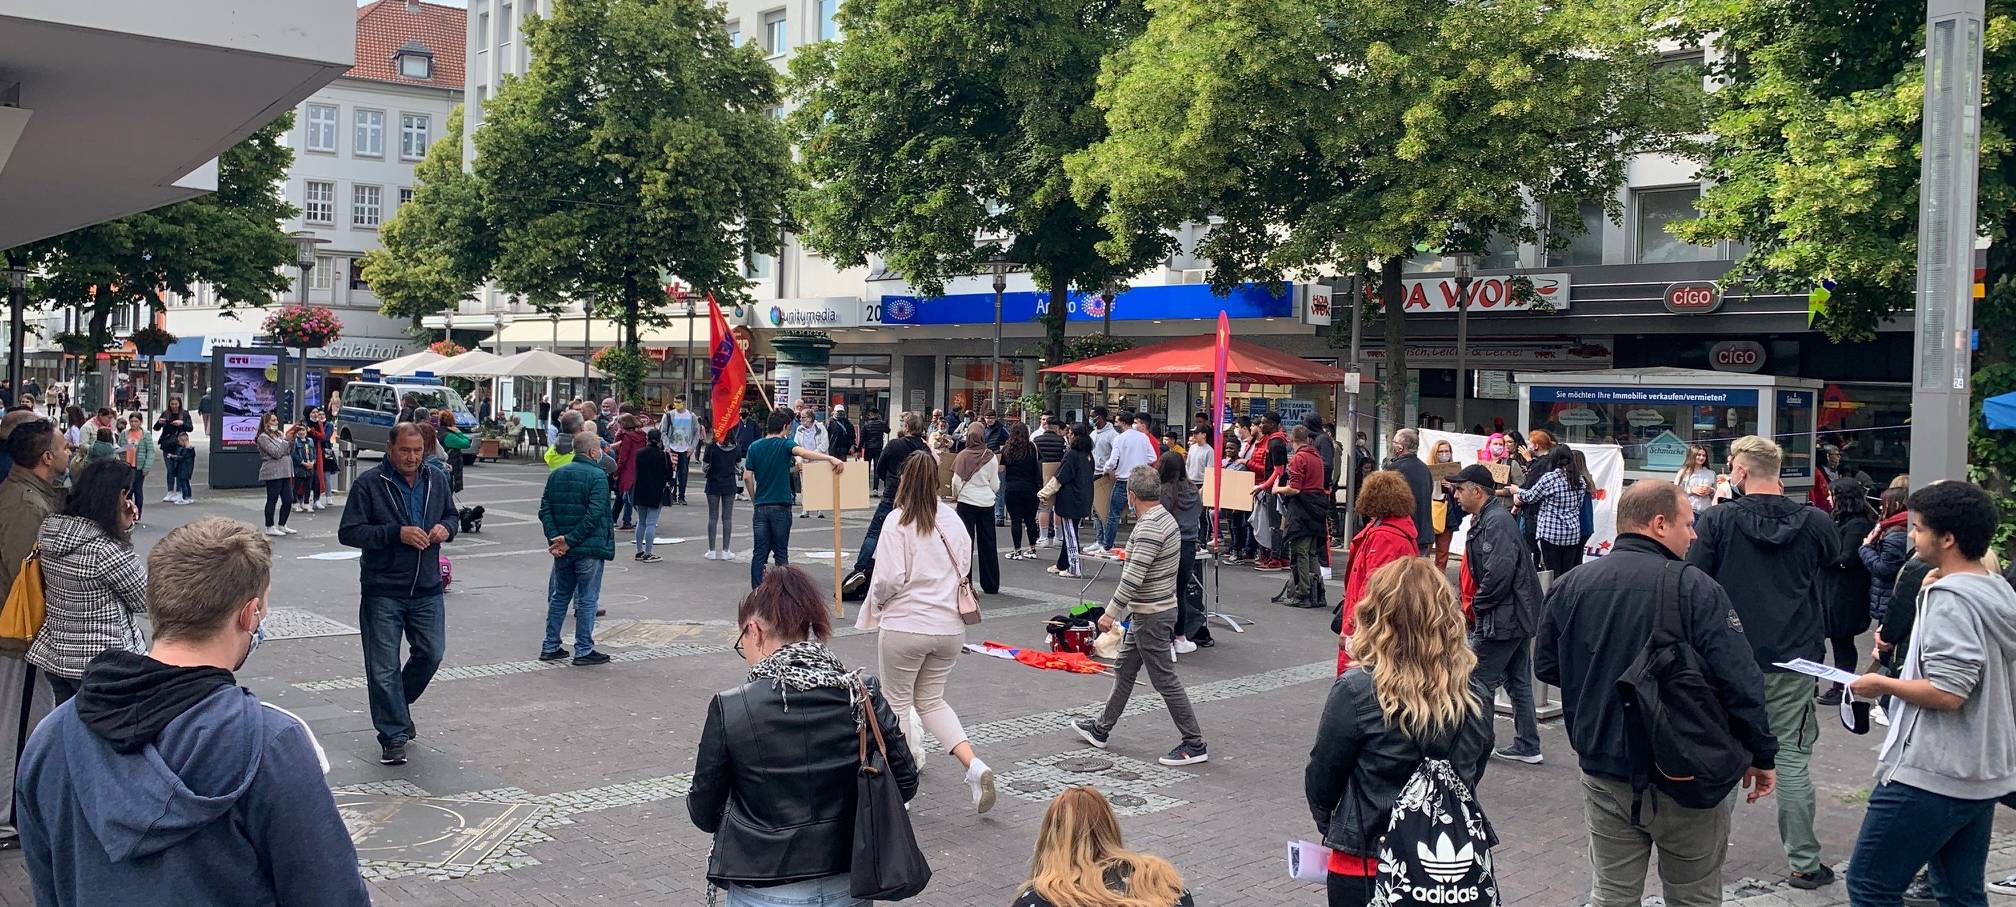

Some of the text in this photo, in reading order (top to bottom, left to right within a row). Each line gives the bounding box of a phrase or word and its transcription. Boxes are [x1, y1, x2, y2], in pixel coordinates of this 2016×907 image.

[783, 308, 836, 325] unitymedia
[1556, 390, 1727, 402] Sie möchten Ihre Immobilie verkaufen/vermieten?
[1412, 885, 1479, 904] adidas
